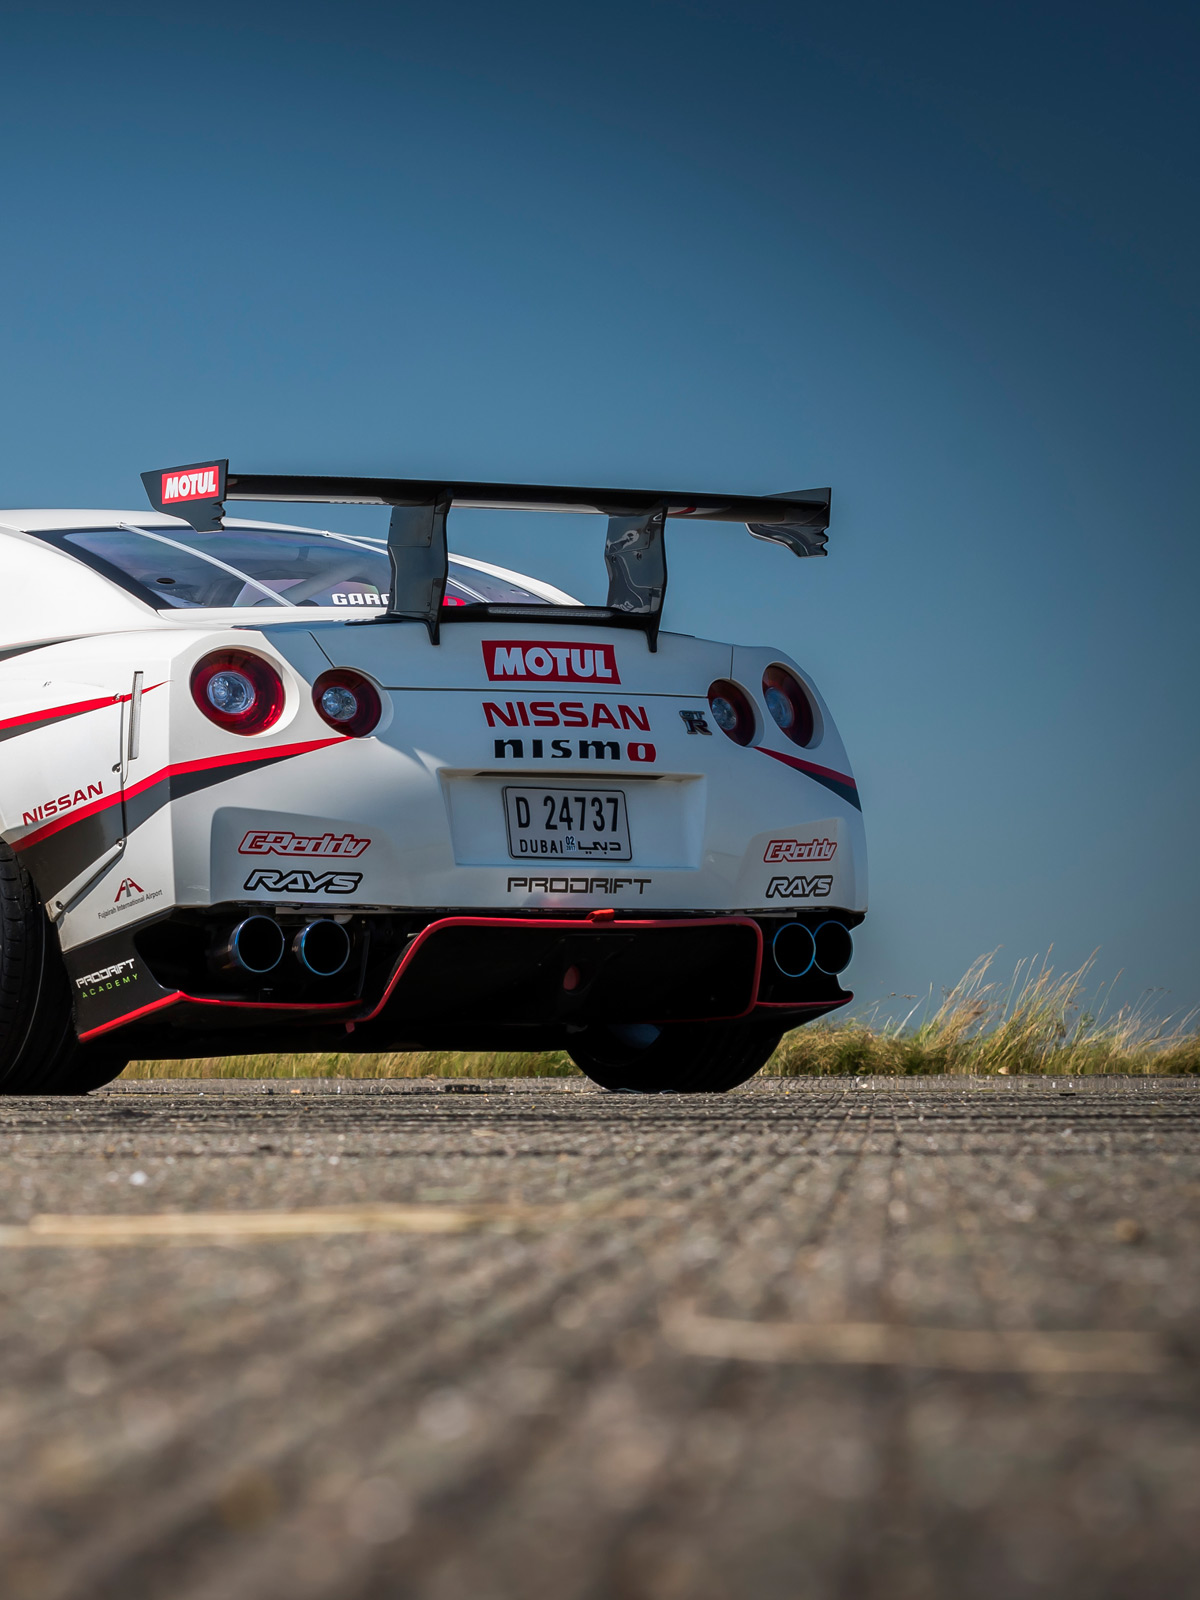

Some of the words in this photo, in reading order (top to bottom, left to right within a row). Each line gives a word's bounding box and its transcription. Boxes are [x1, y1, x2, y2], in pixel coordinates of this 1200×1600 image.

[164, 471, 216, 499] MOTUL
[494, 647, 613, 678] MOTUL
[482, 701, 651, 731] NISSAN
[494, 739, 657, 762] nismo
[22, 781, 103, 826] NISSAN
[515, 796, 531, 828] D
[543, 796, 619, 832] 24737
[520, 839, 564, 854] DUBAI
[566, 836, 575, 845] 02
[578, 841, 621, 854] دبي
[243, 869, 363, 894] RAYS
[507, 877, 651, 894] PRODRIFT
[766, 875, 833, 898] RAYS
[98, 907, 117, 919] Fujairah
[117, 895, 145, 912] International
[146, 889, 163, 900] Airport
[75, 958, 134, 988] PRODRIFT
[82, 973, 138, 998] ACADEMY
